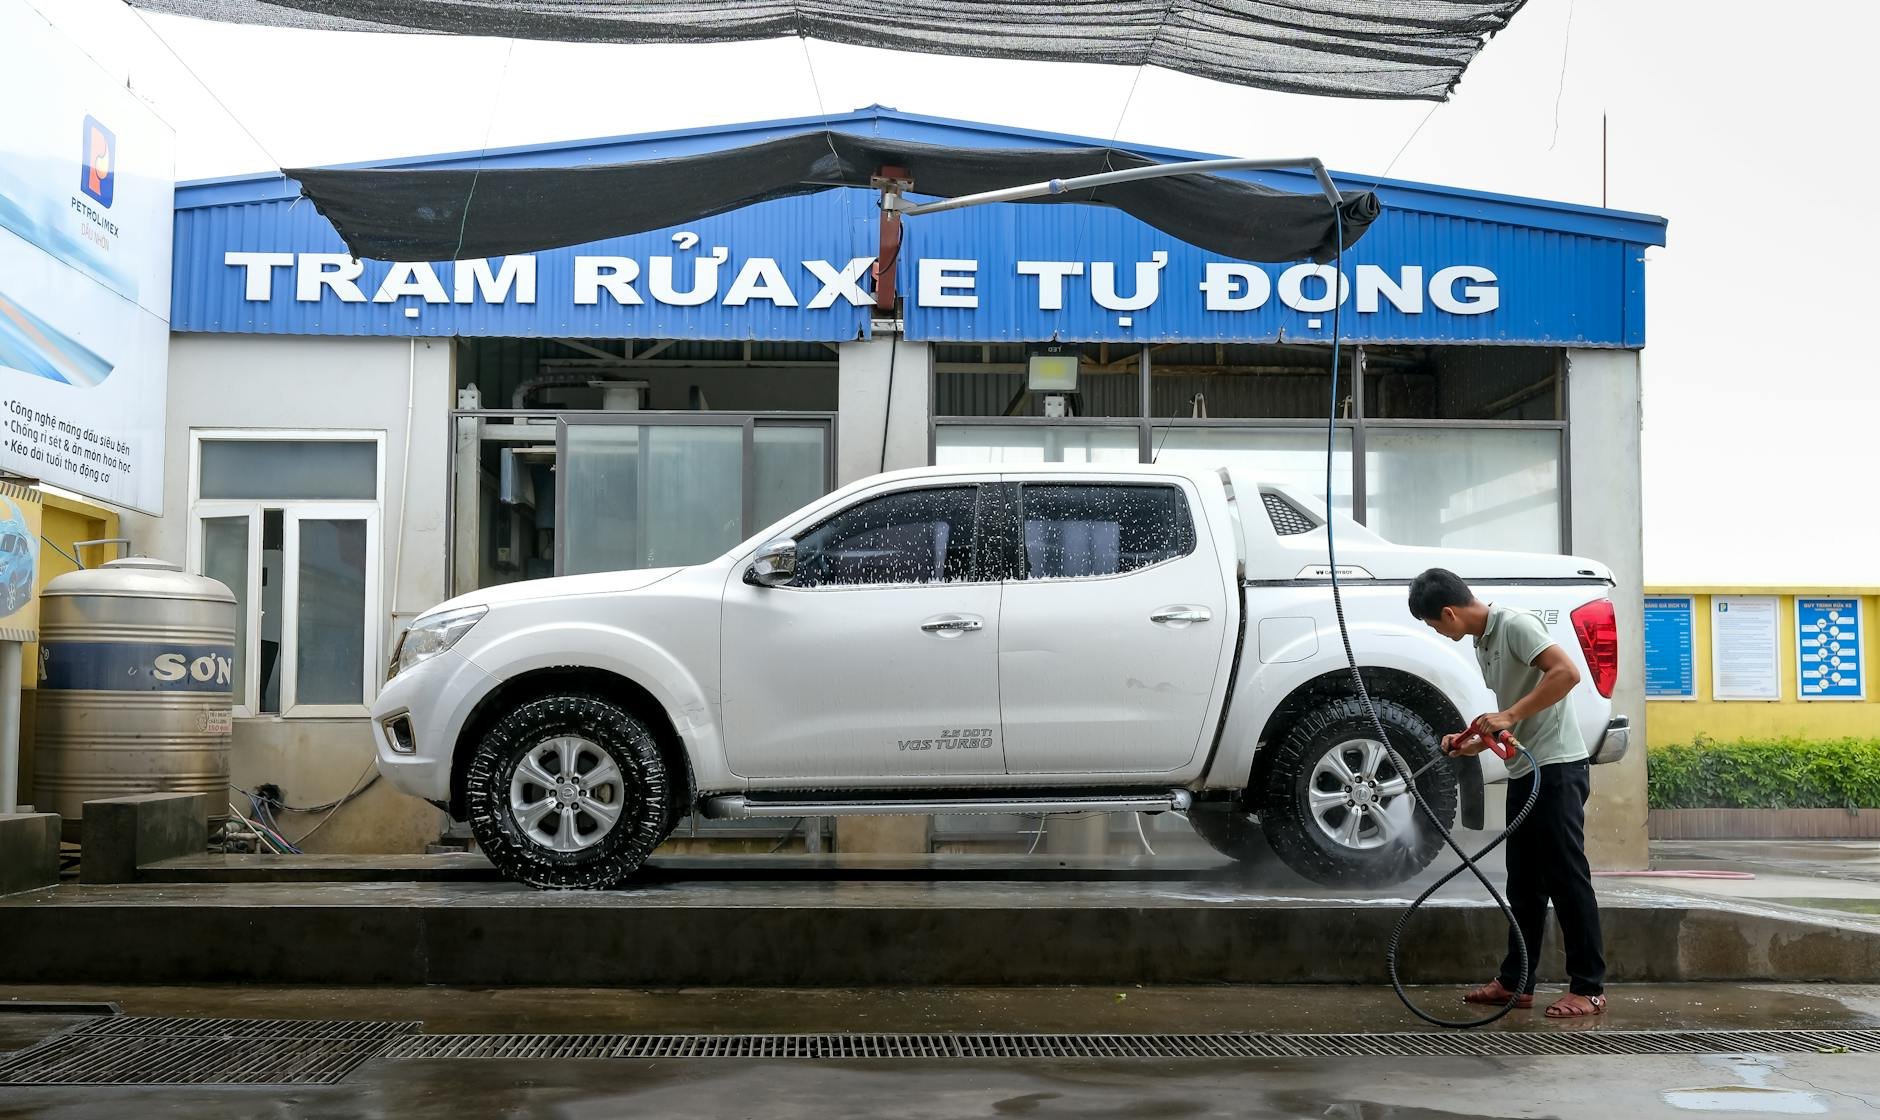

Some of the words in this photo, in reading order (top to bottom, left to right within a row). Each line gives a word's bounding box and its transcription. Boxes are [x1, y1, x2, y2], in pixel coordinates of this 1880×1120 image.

[71, 196, 119, 239] PETROLIMEX
[224, 251, 536, 318] TRẠM
[1017, 250, 1168, 327] TỰ
[10, 400, 33, 422] Công
[34, 411, 57, 430] nghệ
[100, 436, 115, 451] siêu
[11, 420, 38, 443] Chống
[63, 439, 70, 453] &
[118, 458, 131, 475] học
[10, 439, 28, 456] Kéo
[64, 458, 77, 475] thọ
[79, 463, 99, 483] động
[100, 472, 111, 483] cơ
[898, 739, 933, 751] VGS
[935, 737, 993, 750] TURBO
[940, 729, 961, 738] 2.5
